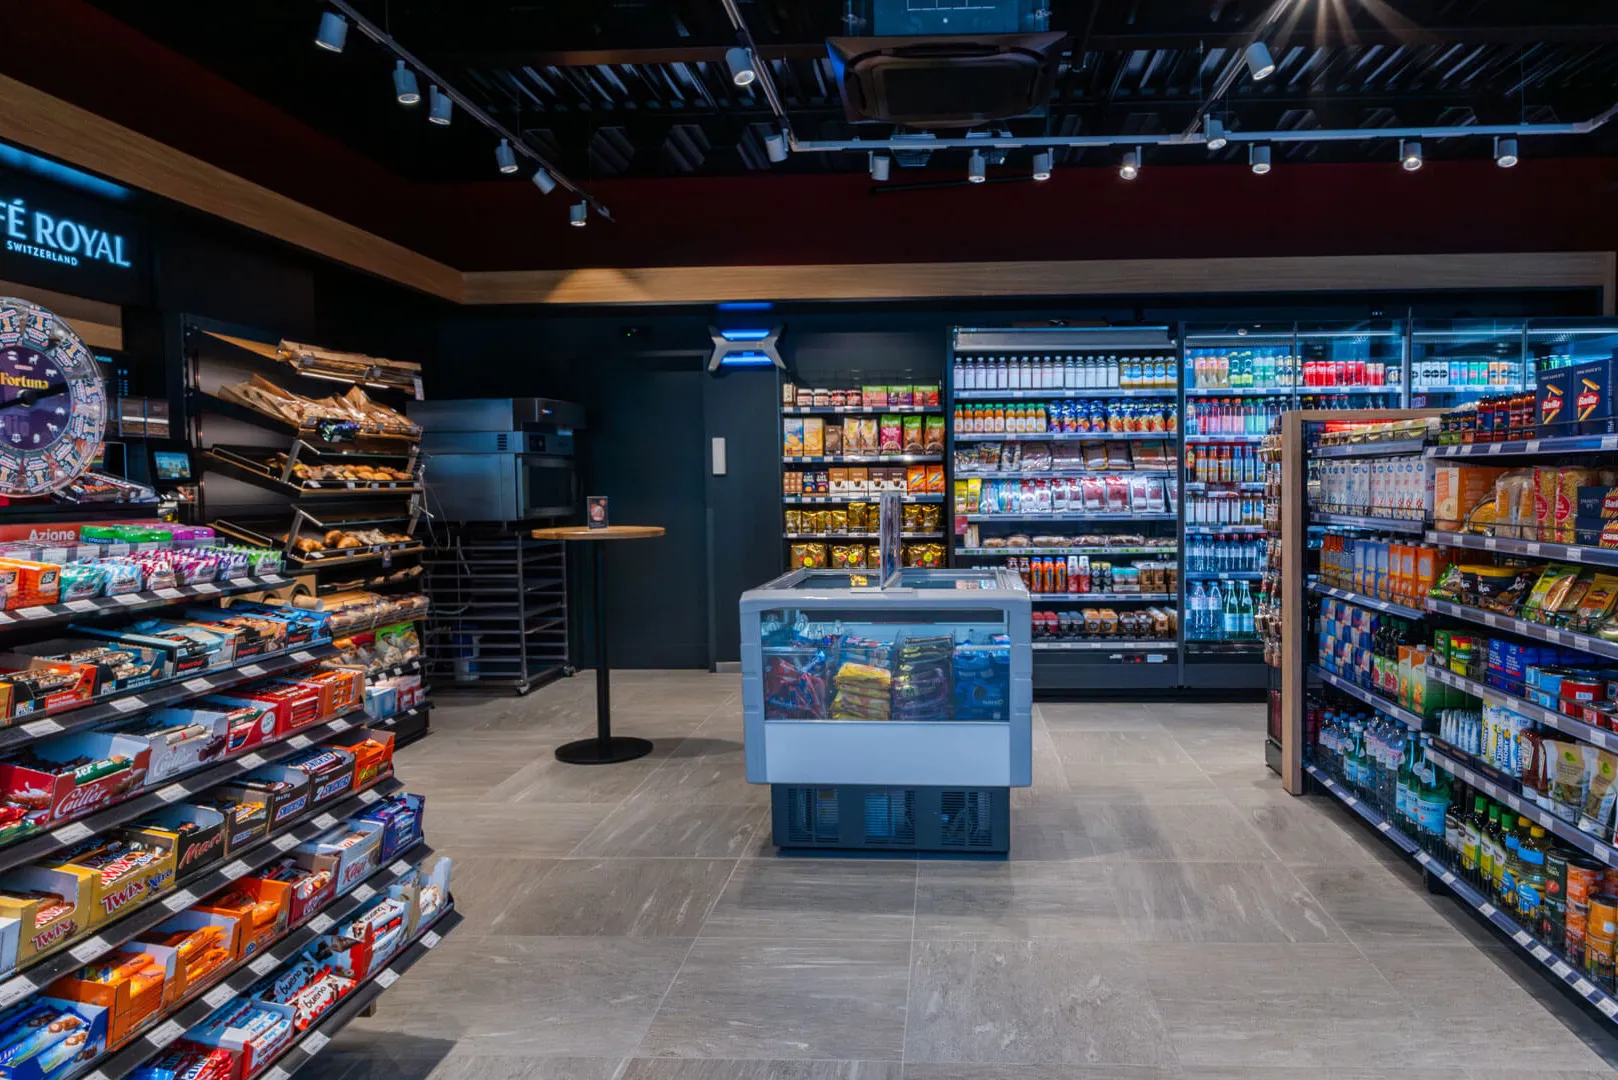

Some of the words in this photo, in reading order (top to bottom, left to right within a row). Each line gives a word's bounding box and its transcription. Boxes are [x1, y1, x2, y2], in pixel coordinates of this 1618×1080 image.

[34, 211, 132, 268] ROYAL
[6, 240, 78, 266] SWITZERLAND
[0, 372, 49, 389] Fortuna
[29, 529, 75, 541] Azione
[323, 772, 352, 797] SNICKERS
[54, 784, 107, 819] Cailler
[277, 796, 307, 820] SNICKERS
[178, 829, 225, 870] Mars
[101, 880, 145, 914] Twix
[148, 868, 173, 893] Xtra
[31, 920, 70, 950] Twix
[278, 970, 303, 995] bueno
[303, 986, 327, 1009] bueno
